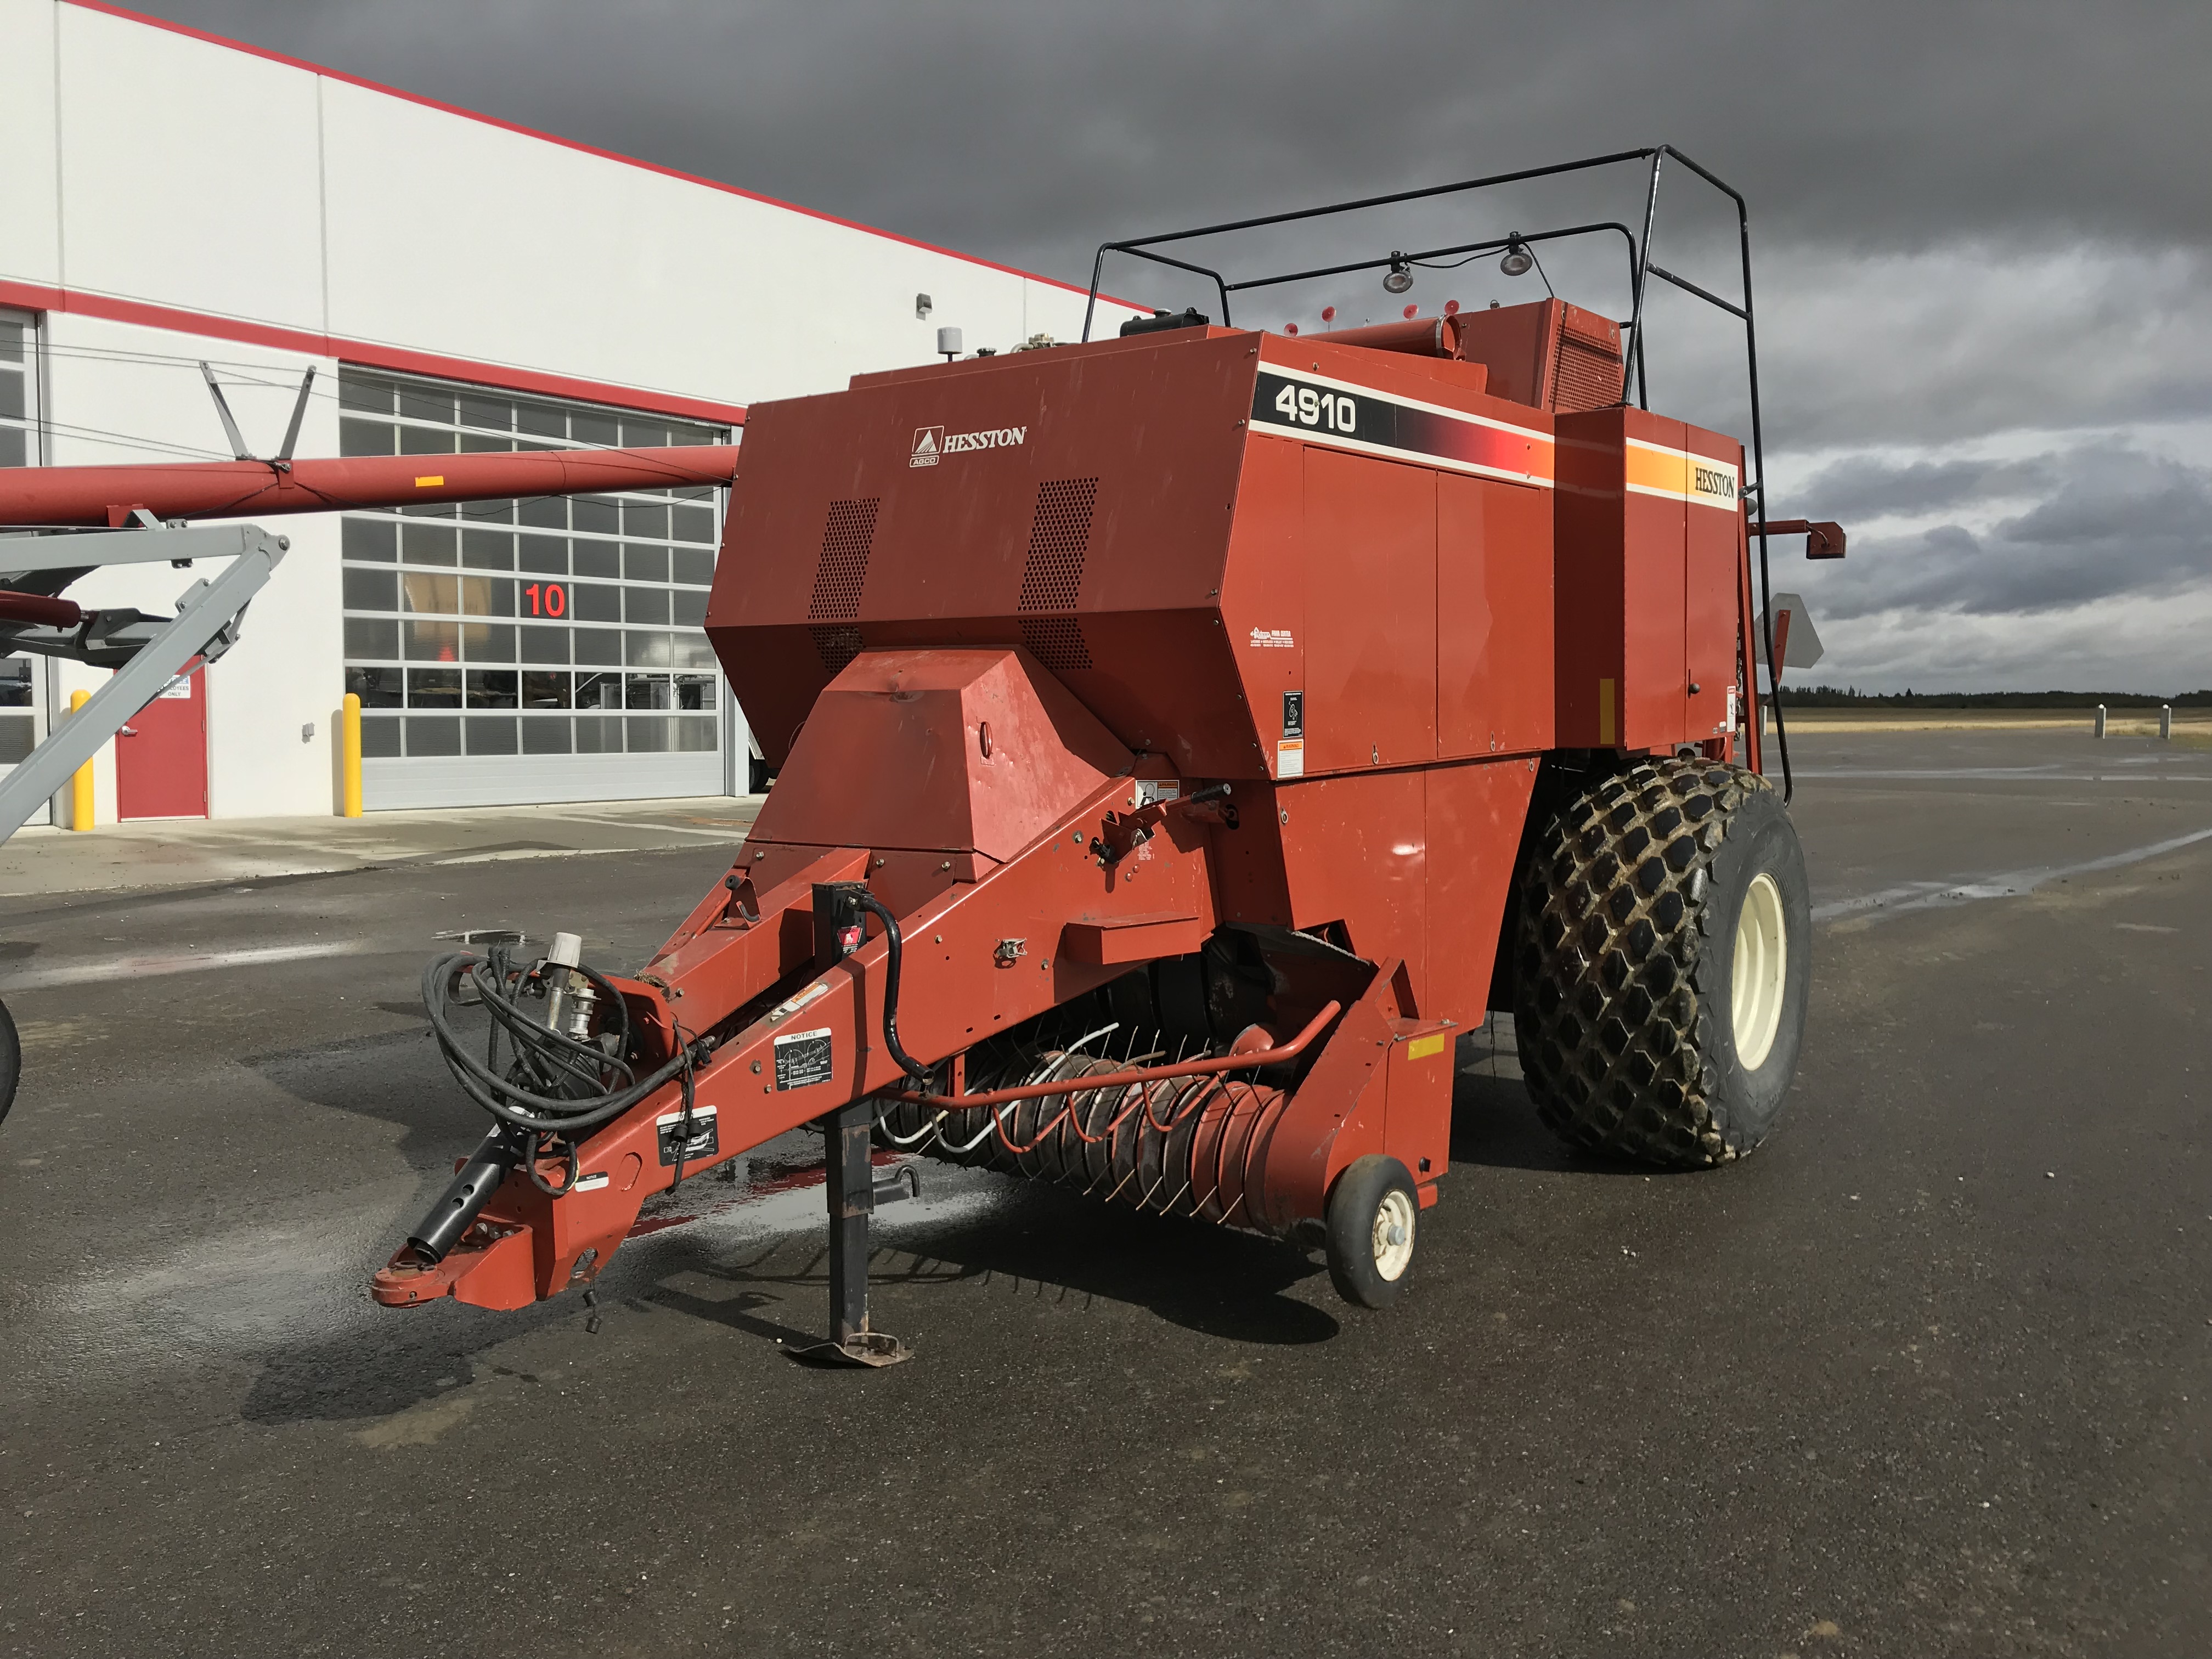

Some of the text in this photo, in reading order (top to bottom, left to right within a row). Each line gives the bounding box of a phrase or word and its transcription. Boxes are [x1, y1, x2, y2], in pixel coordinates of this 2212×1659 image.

[1276, 384, 1356, 433] 4910
[943, 426, 1027, 453] HESSTON
[913, 458, 936, 466] AGCO
[1695, 467, 1735, 499] HESSTON
[525, 583, 565, 617] 10
[791, 1031, 817, 1041] NOTICE
